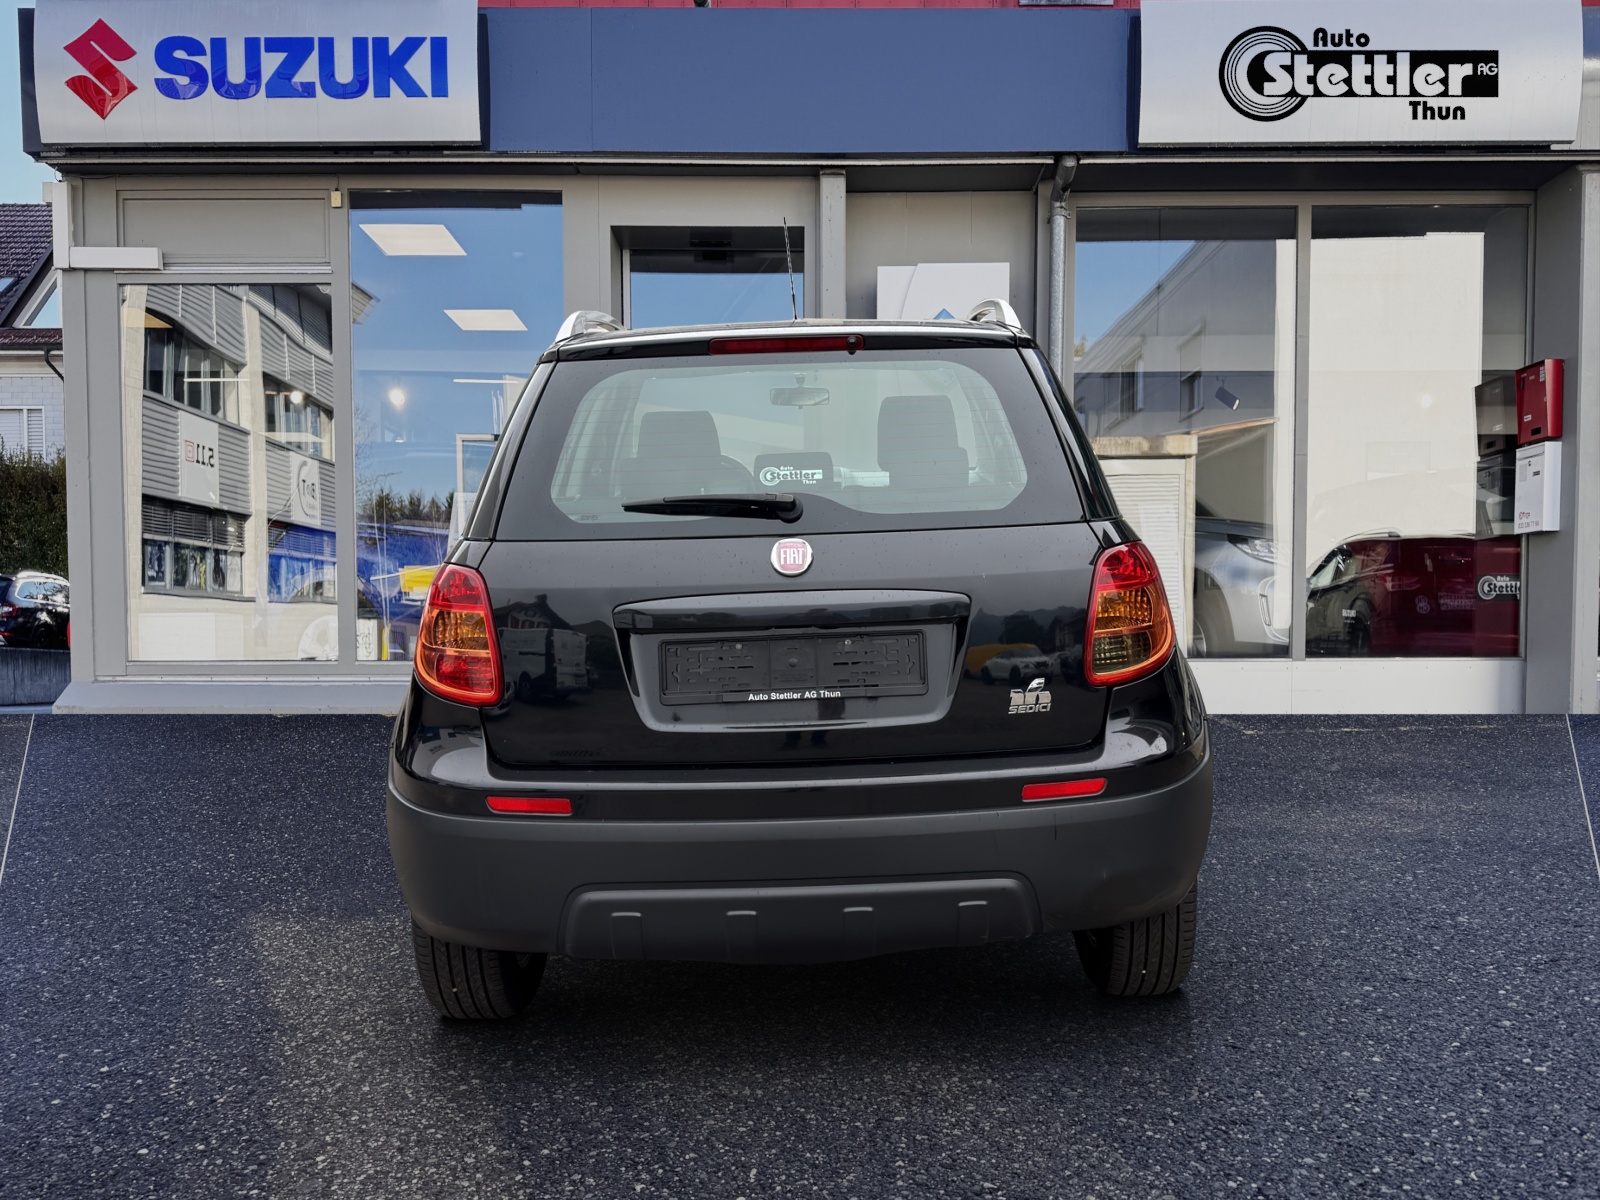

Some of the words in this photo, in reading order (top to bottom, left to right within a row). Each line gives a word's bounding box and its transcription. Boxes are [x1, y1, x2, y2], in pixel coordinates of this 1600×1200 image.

[1313, 27, 1370, 48] Auto
[154, 35, 449, 99] SUZUKI
[1263, 51, 1473, 96] Stettler
[1477, 63, 1498, 75] AG
[1409, 101, 1466, 120] Thun
[769, 471, 818, 480] Stettler
[780, 547, 805, 565] FIAT
[748, 693, 769, 701] Auto
[770, 691, 802, 700] Stettler
[804, 690, 817, 699] AG
[819, 690, 841, 698] Thun
[1008, 702, 1052, 714] SEDICI
